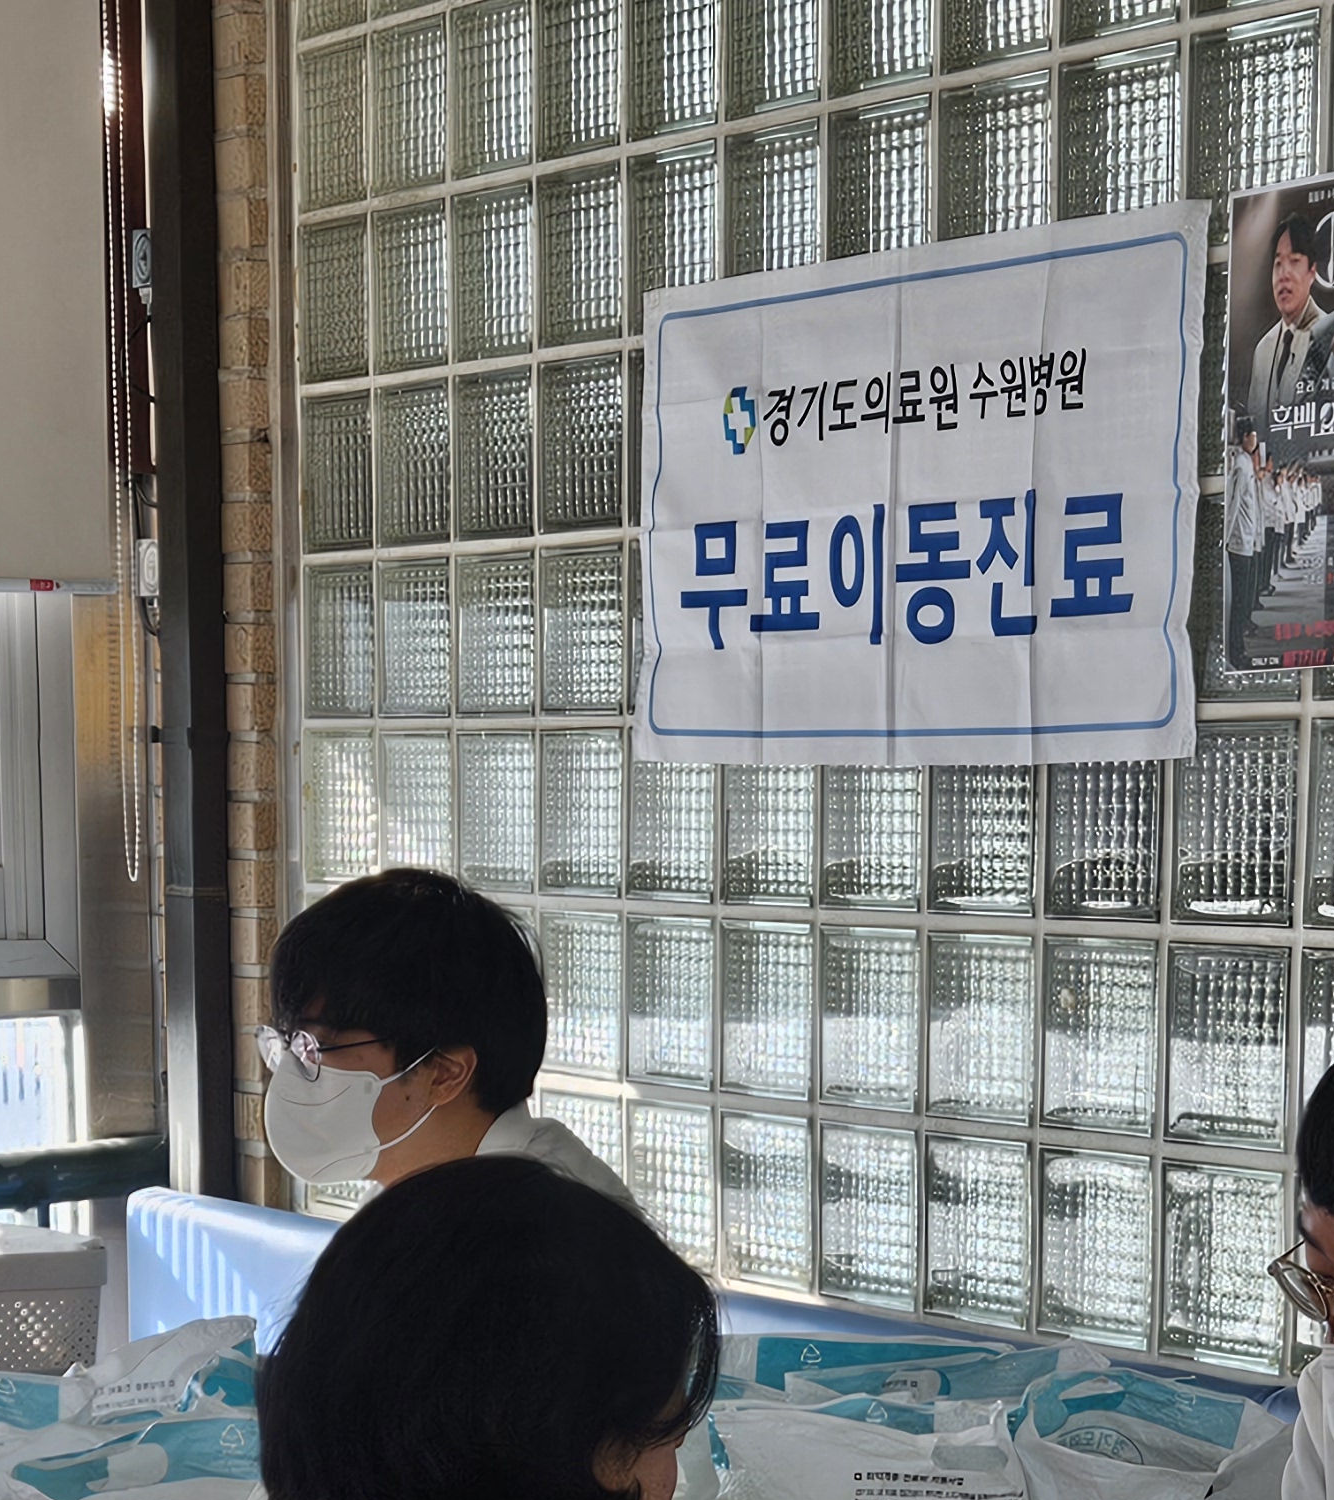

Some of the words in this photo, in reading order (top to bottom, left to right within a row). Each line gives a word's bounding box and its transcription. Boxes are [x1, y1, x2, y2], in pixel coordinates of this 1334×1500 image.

[762, 363, 960, 447] 경기도의료원
[969, 348, 1087, 420] 수원병원
[680, 488, 1134, 650] 무료이동진료
